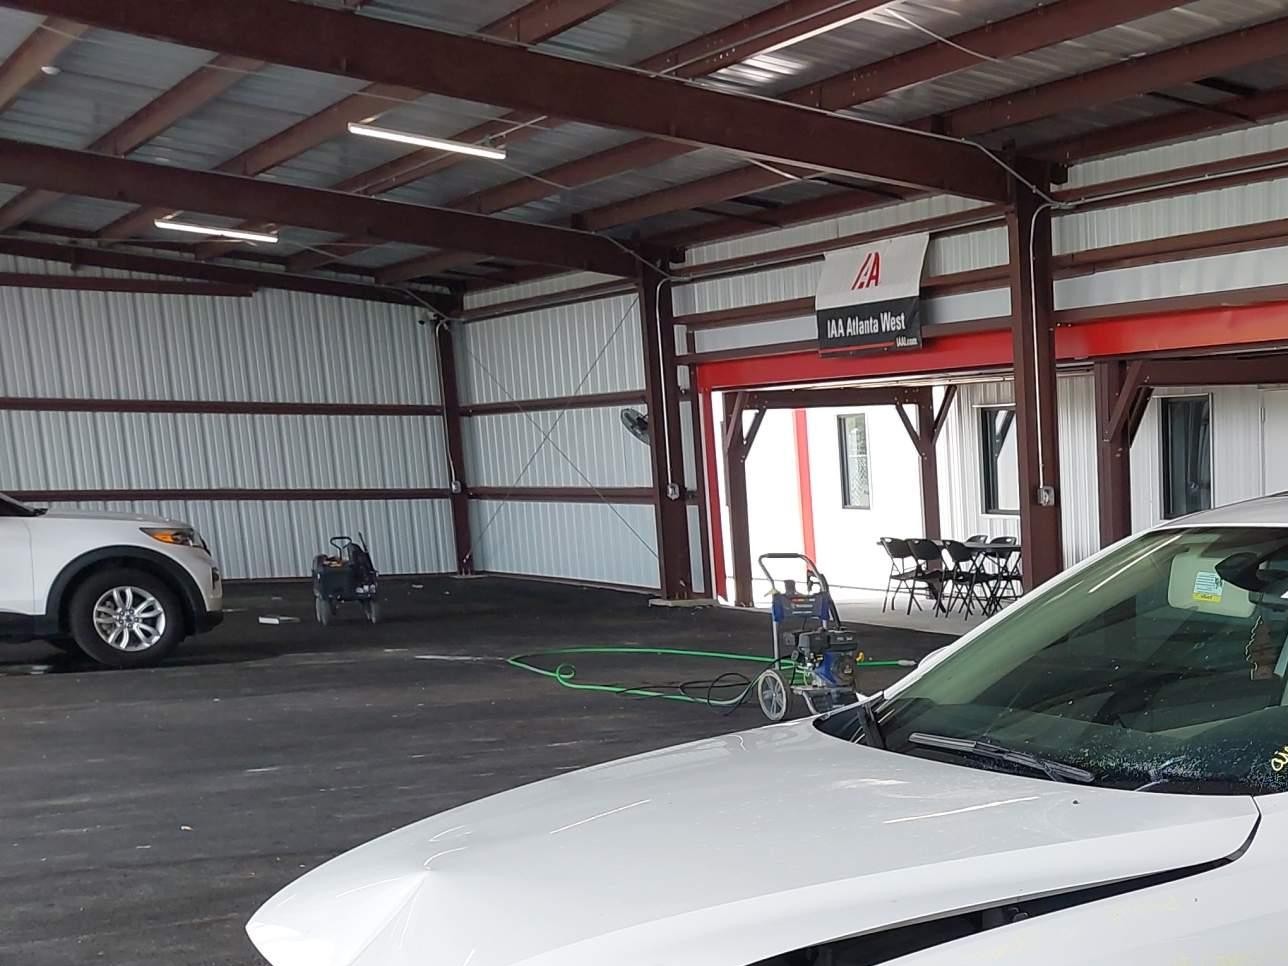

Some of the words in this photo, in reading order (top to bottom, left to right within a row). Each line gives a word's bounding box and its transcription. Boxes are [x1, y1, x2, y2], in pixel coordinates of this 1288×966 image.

[828, 319, 845, 338] IAA
[846, 315, 879, 337] Atlanta
[880, 312, 905, 332] West
